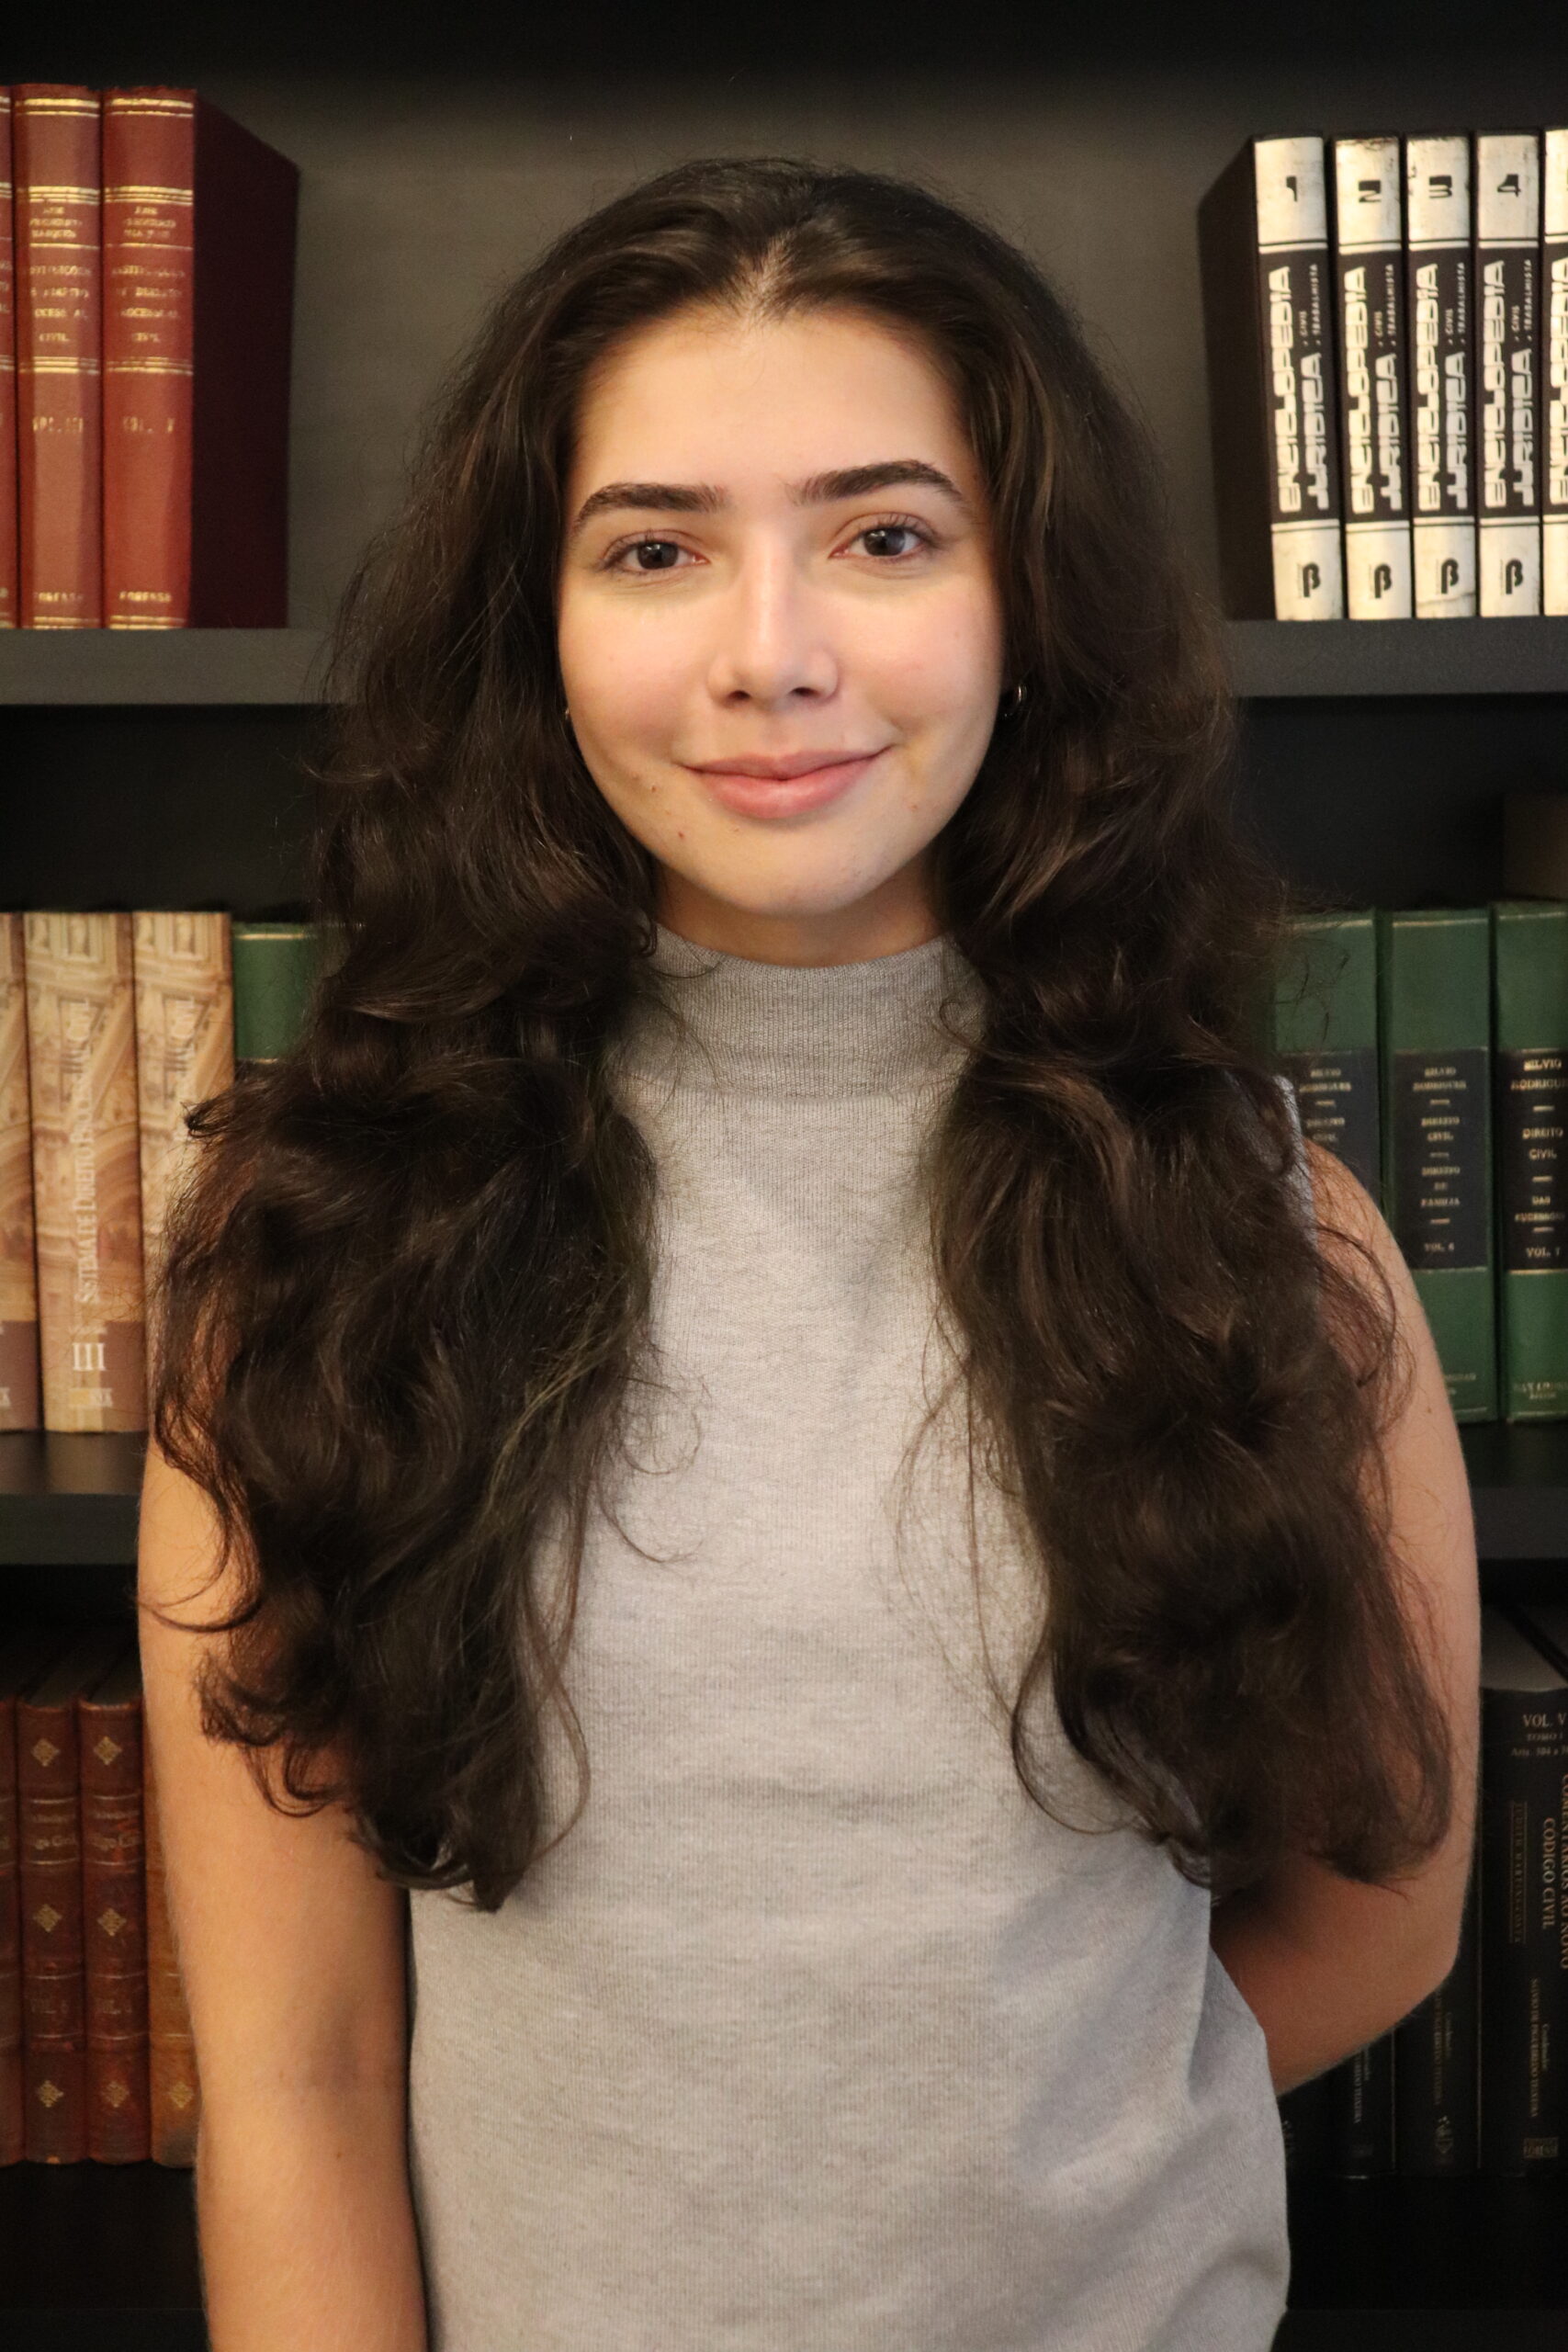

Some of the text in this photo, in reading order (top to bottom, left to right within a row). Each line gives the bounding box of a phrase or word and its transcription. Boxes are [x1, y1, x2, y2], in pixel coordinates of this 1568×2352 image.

[1358, 178, 1382, 203] 2
[1428, 175, 1453, 199] 3
[1496, 173, 1521, 198] 4
[1522, 1127, 1564, 1139] DIREITO
[1529, 1148, 1558, 1160] CIVIL
[1522, 1713, 1553, 1728] VOL.
[1542, 1887, 1556, 1930] CIVIL
